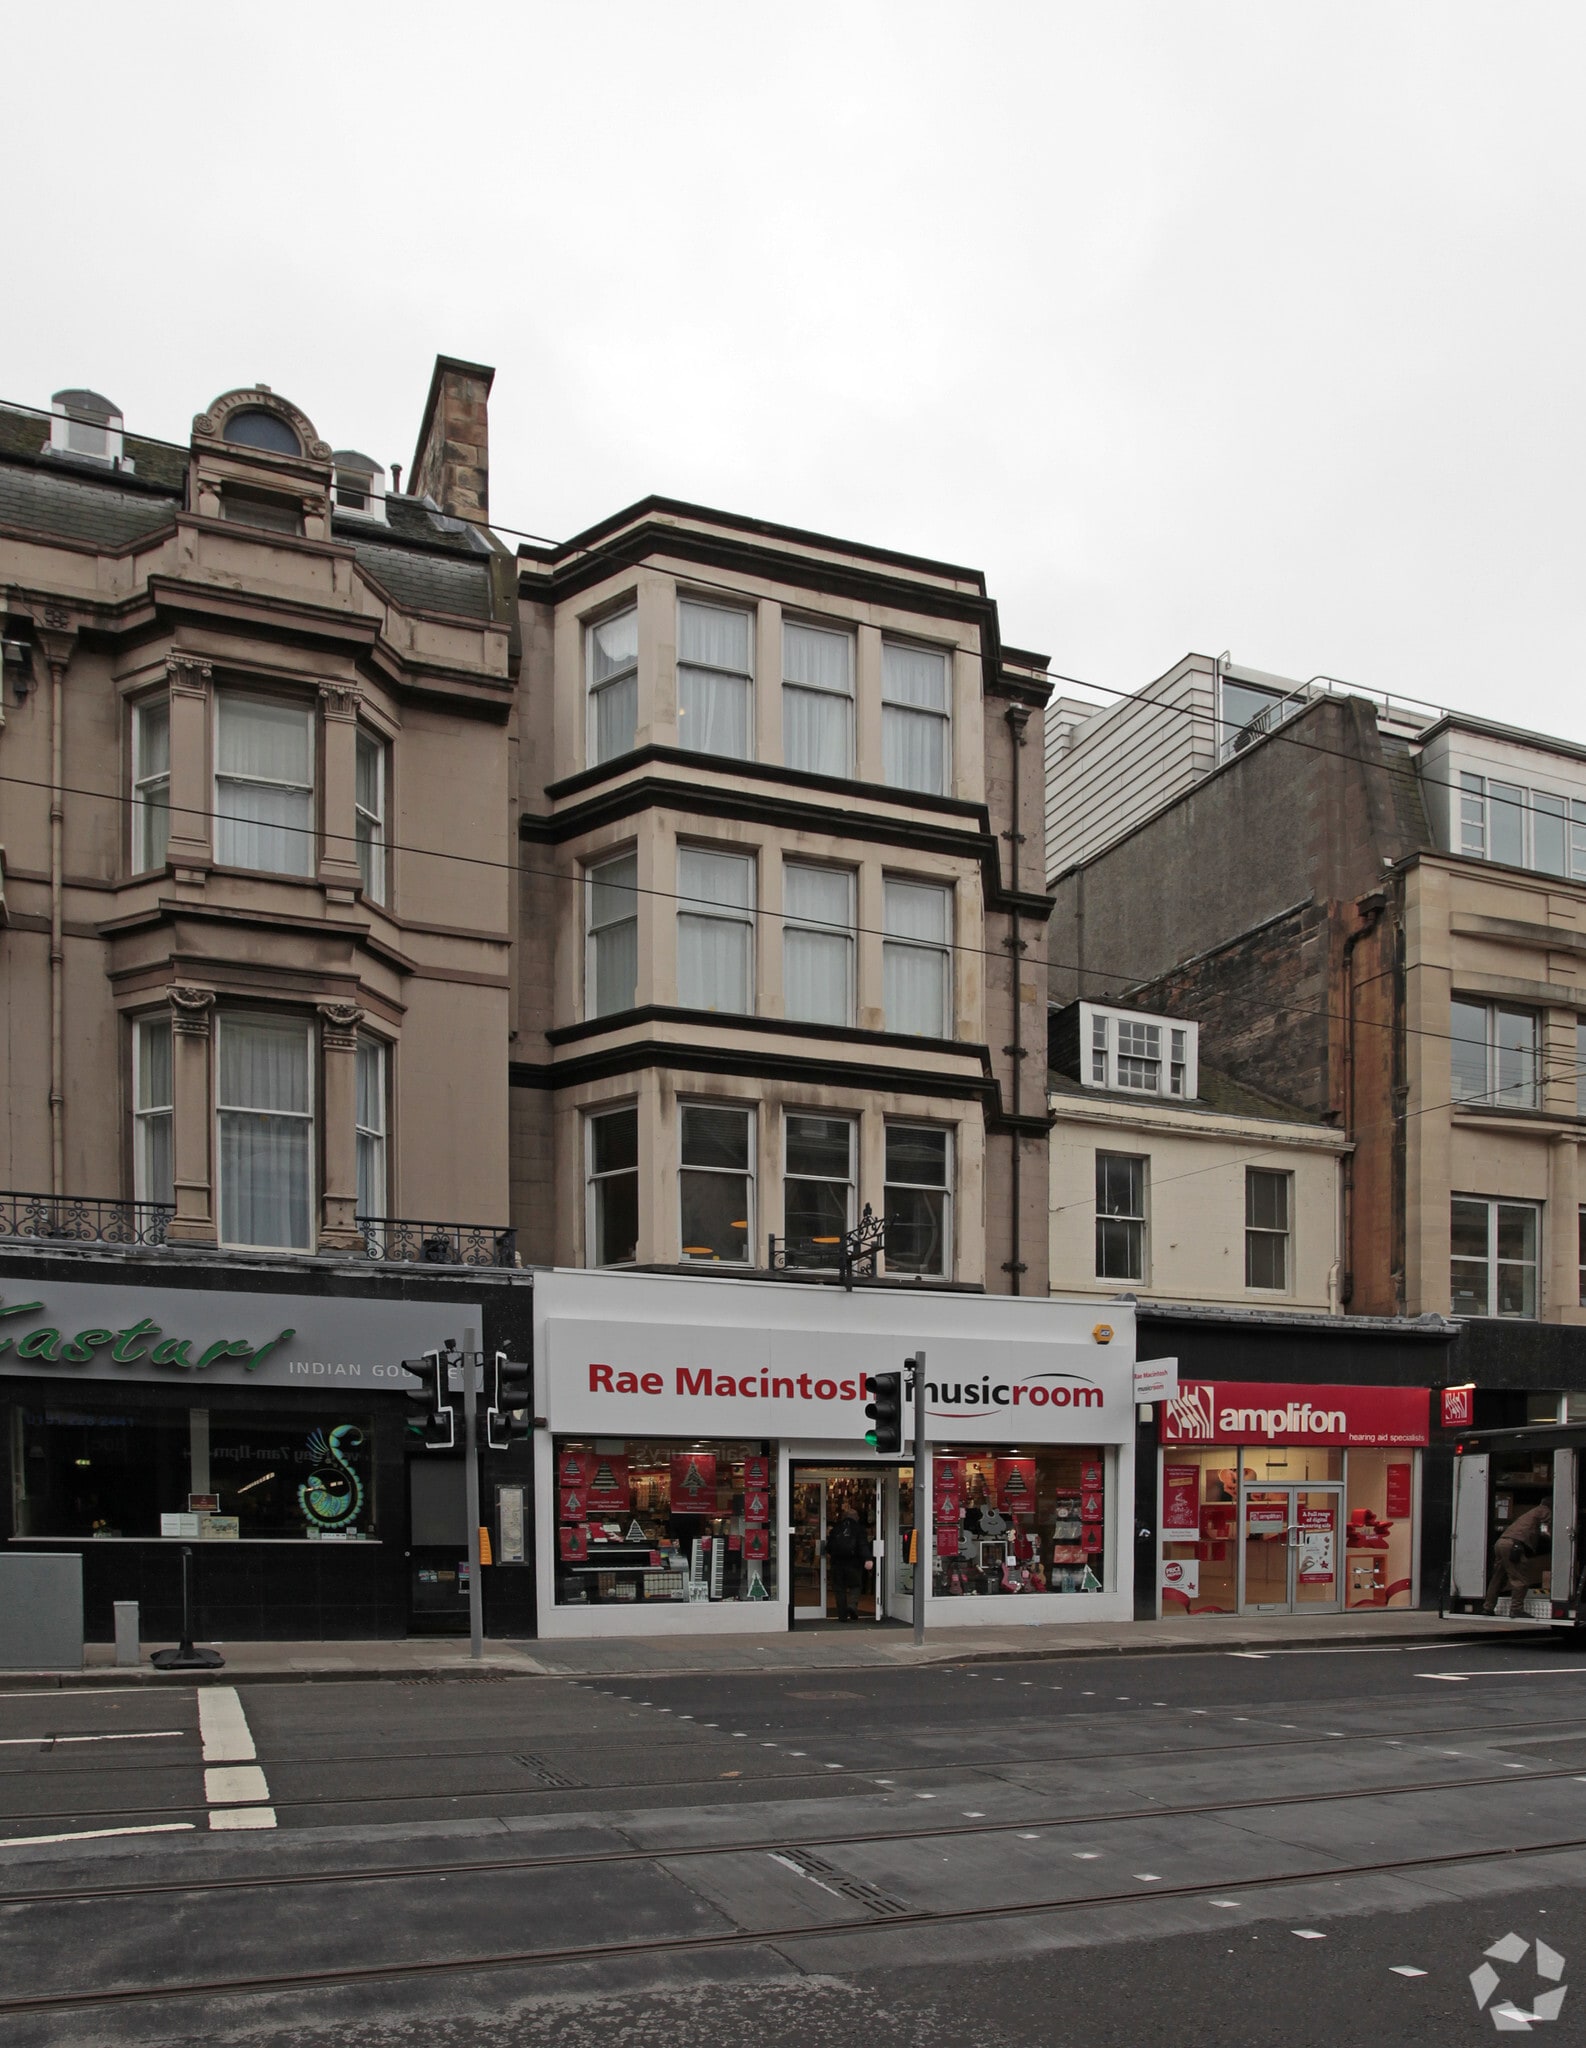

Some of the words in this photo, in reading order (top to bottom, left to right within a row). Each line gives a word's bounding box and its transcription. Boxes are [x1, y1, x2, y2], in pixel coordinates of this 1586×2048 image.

[0, 1296, 296, 1370] asturi
[289, 1361, 361, 1376] INDIAN
[1143, 1370, 1168, 1378] Macintosh
[589, 1364, 663, 1394] Rae
[1137, 1384, 1164, 1392] musicroom
[1219, 1402, 1346, 1438] amplifon
[1349, 1433, 1375, 1443] hearing
[1377, 1433, 1388, 1441] aid
[1390, 1433, 1425, 1443] specialists
[1312, 1516, 1328, 1524] digital
